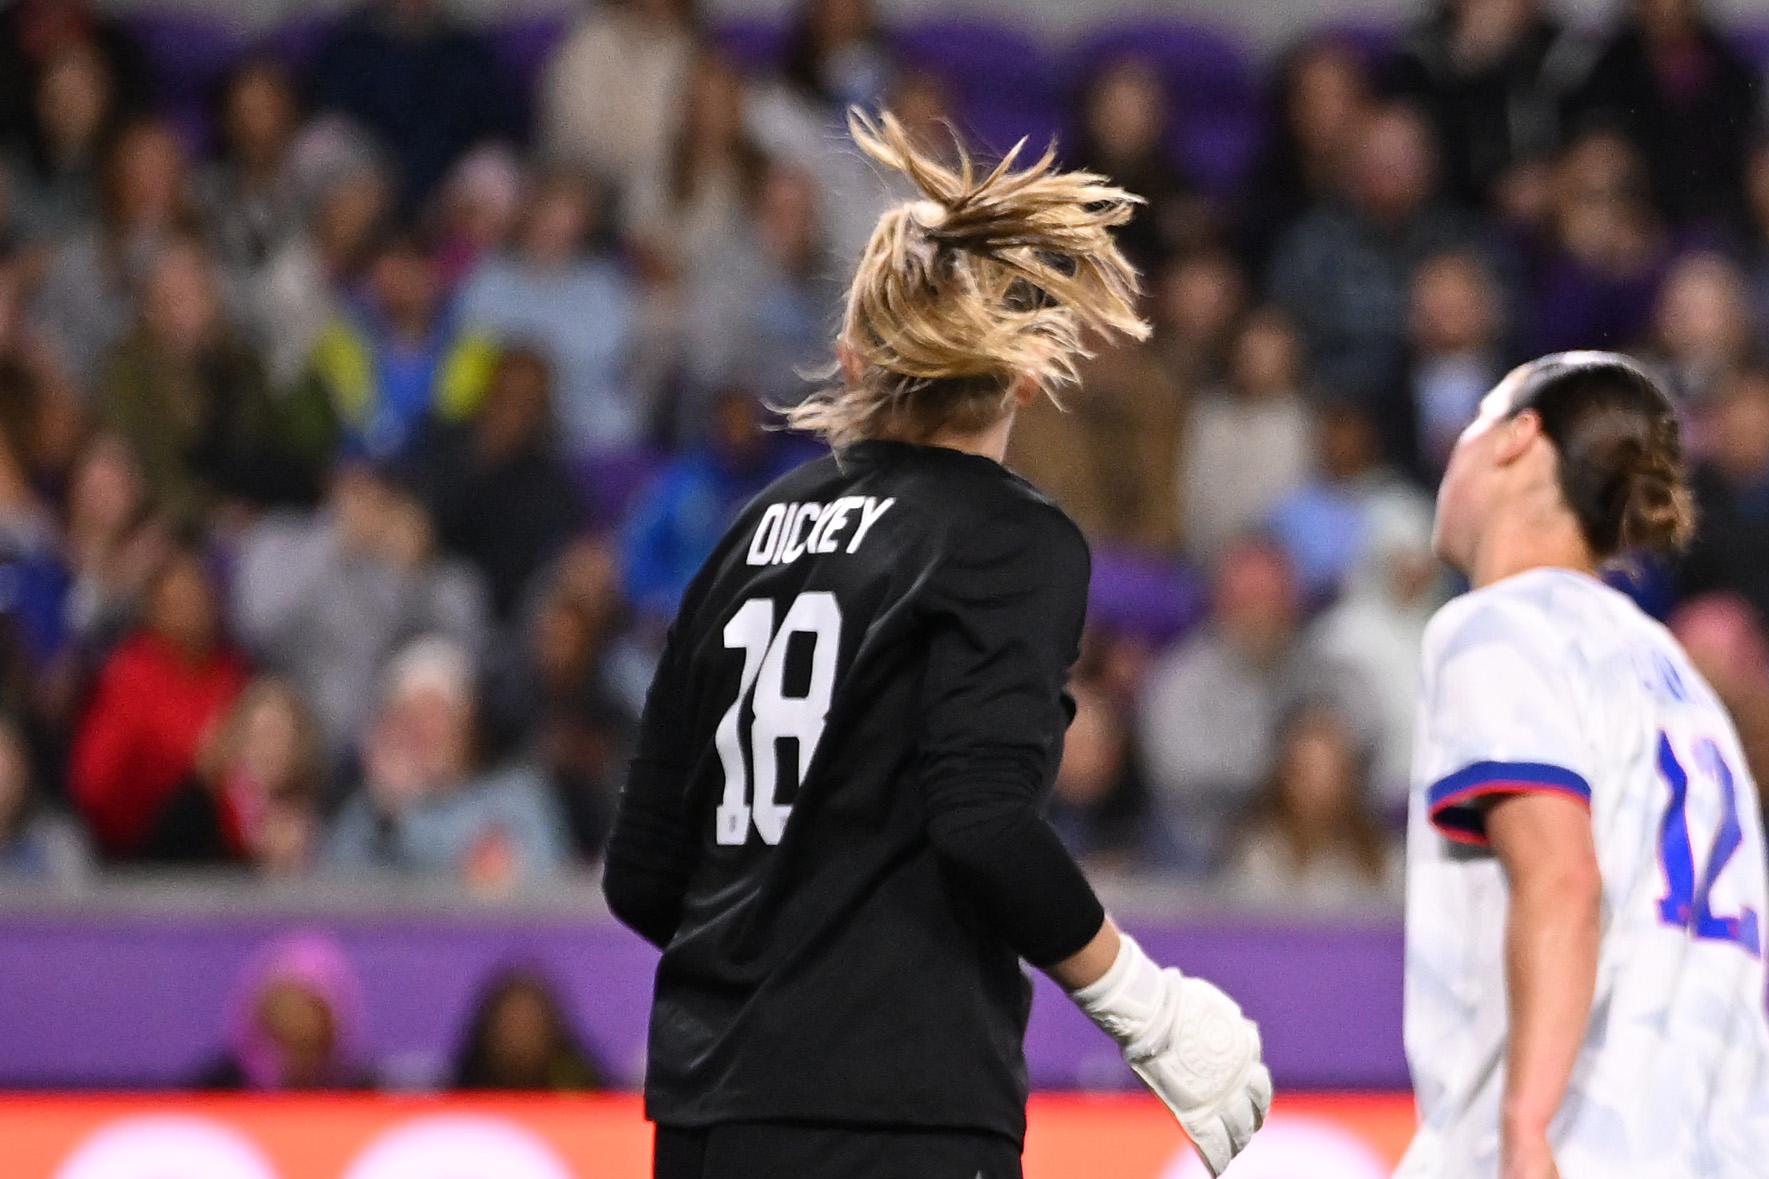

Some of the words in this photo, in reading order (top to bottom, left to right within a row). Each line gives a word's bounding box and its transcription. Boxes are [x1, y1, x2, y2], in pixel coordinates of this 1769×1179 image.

[746, 496, 896, 565] DICKEY
[715, 591, 842, 845] 18
[1656, 730, 1761, 961] 12
